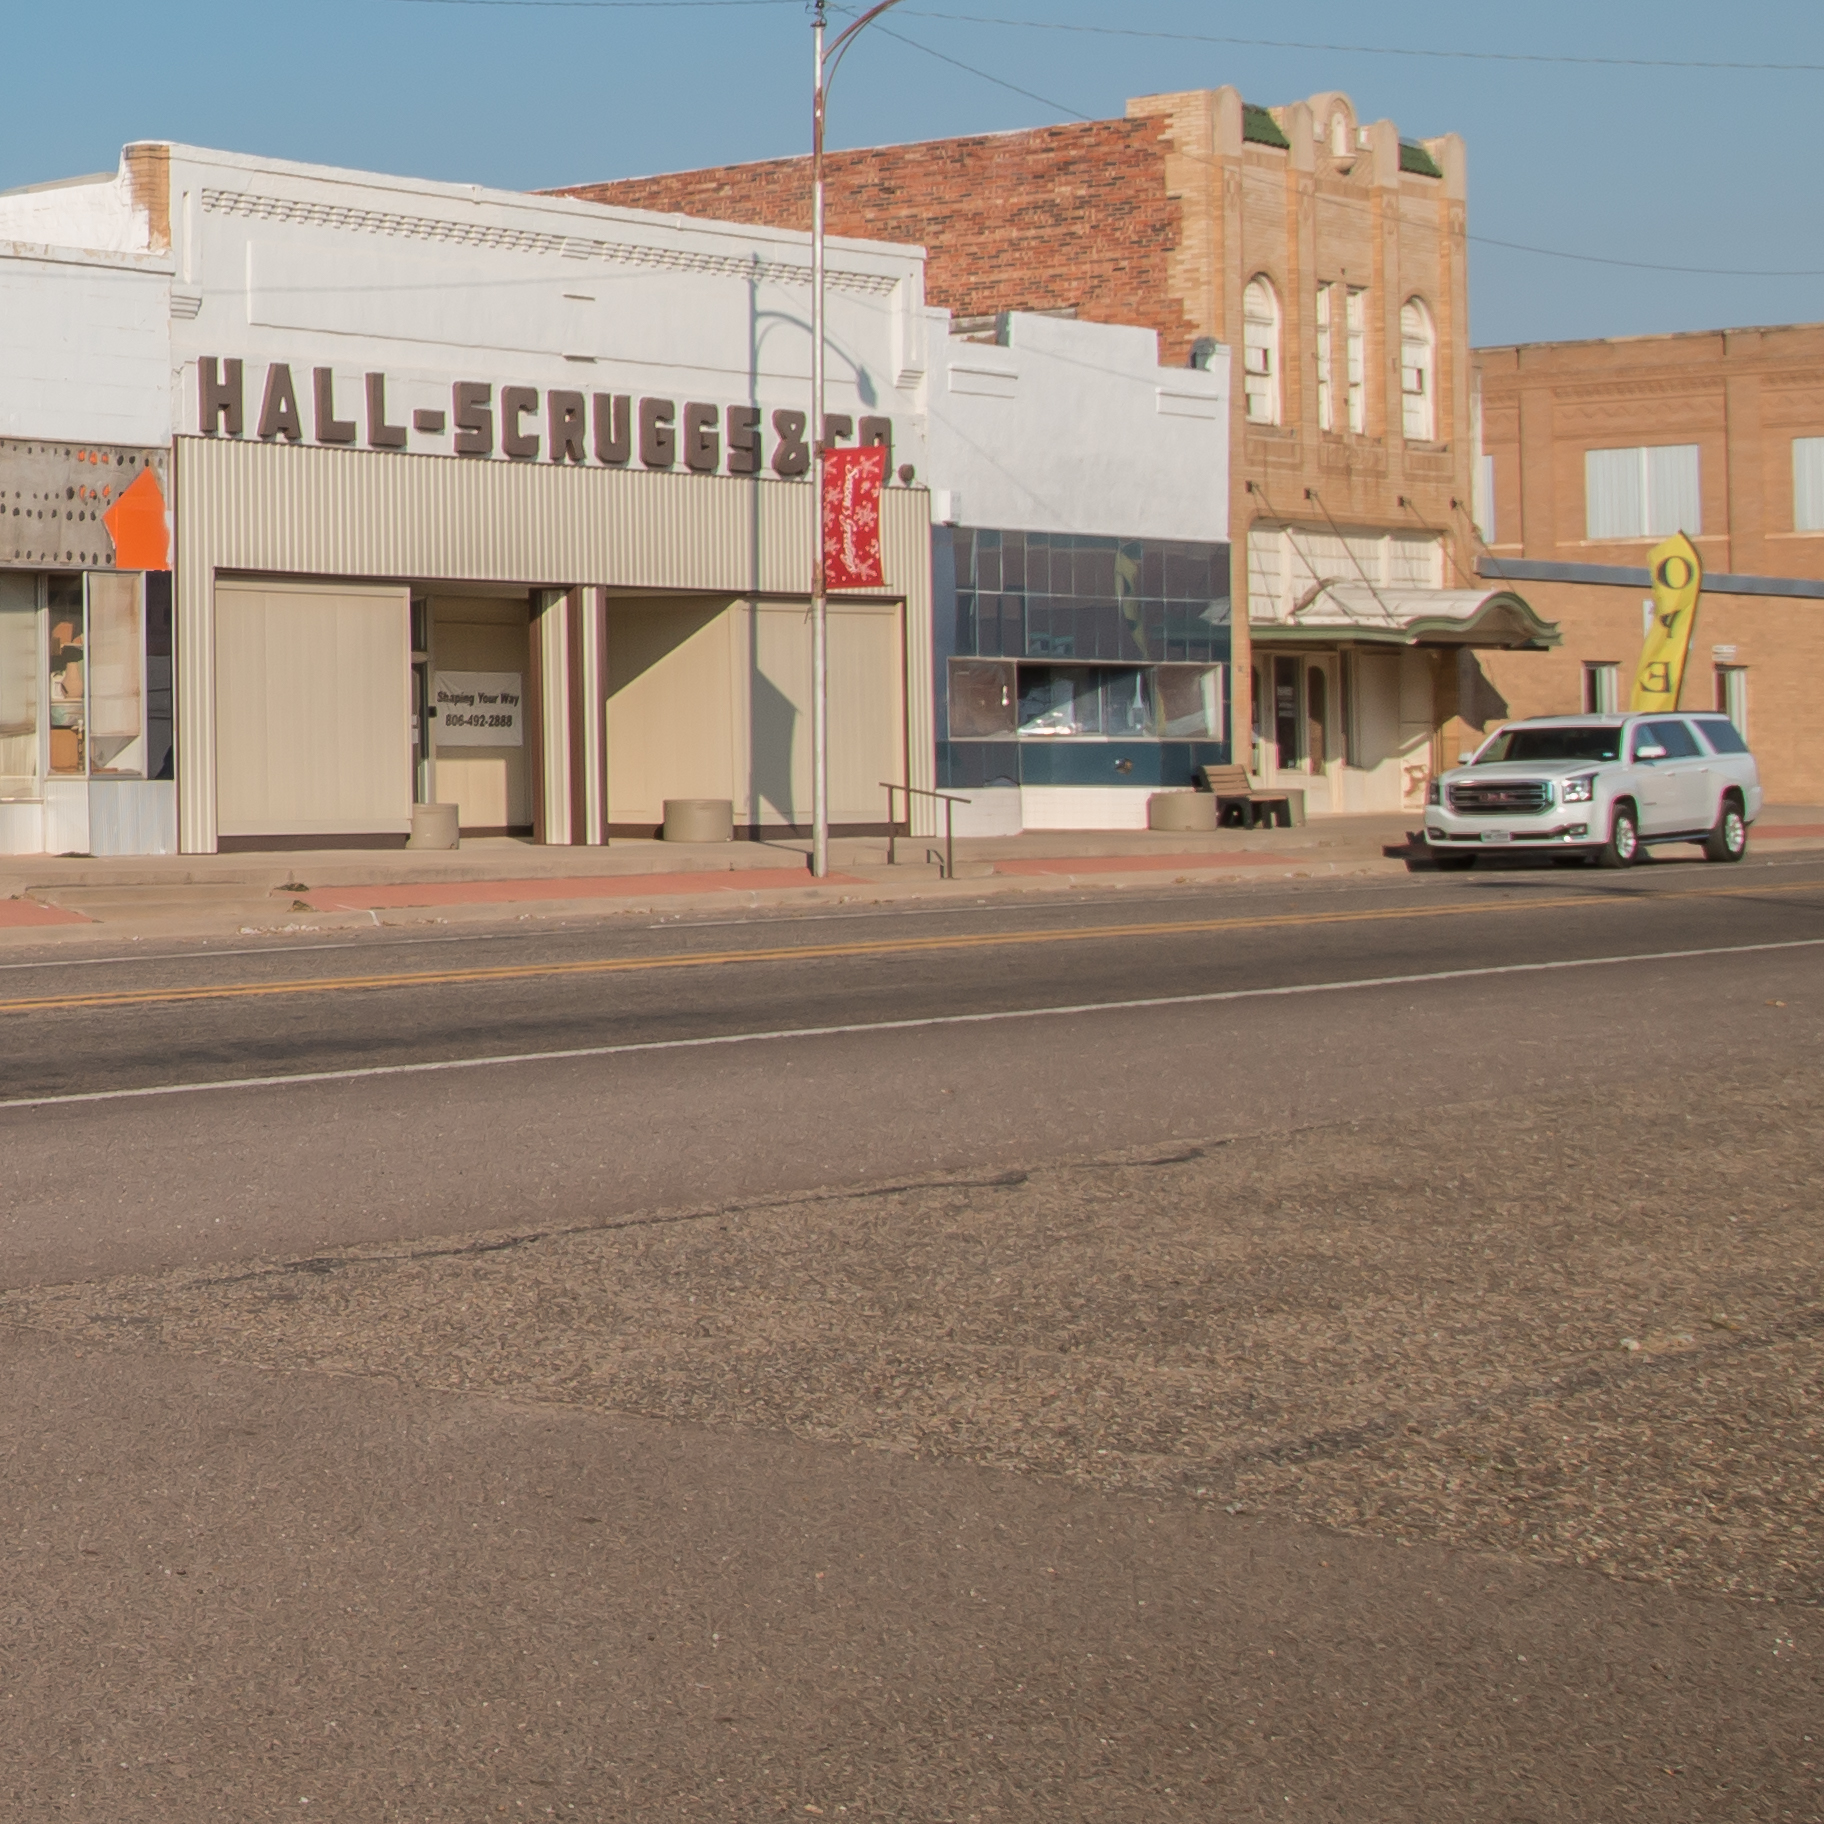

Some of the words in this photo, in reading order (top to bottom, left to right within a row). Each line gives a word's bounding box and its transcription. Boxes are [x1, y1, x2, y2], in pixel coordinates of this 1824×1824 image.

[437, 691, 475, 707] Shaping
[477, 692, 499, 704] Your
[500, 692, 520, 707] Way
